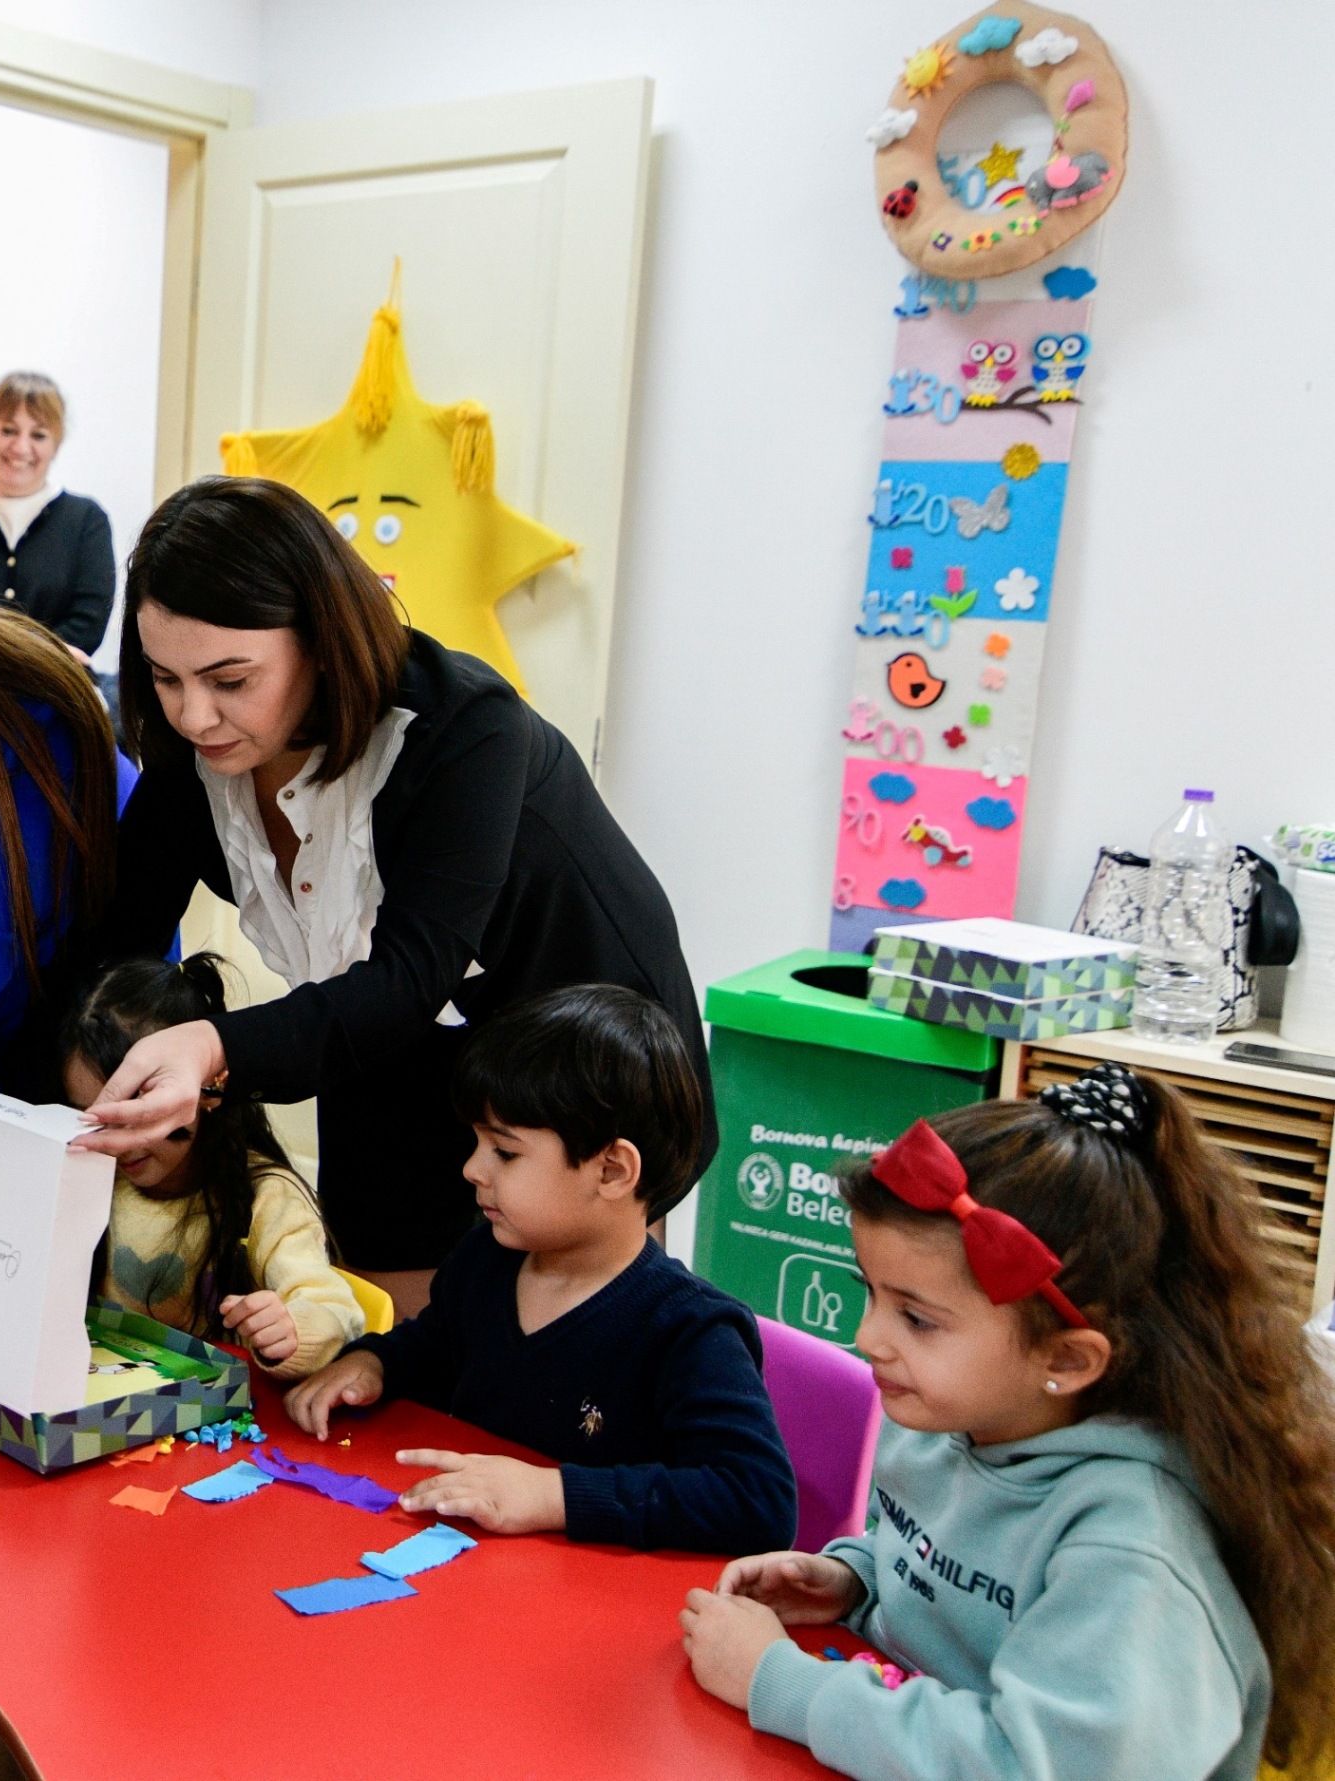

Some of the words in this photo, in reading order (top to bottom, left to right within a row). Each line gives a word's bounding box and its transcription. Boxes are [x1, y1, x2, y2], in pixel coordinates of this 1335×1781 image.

[883, 367, 962, 425] 130
[867, 479, 950, 534] 120
[855, 590, 951, 648] 110
[842, 695, 925, 763] 100
[844, 792, 882, 845] 90
[750, 1124, 828, 1149] Bornova
[930, 1549, 1015, 1622] HILFIG
